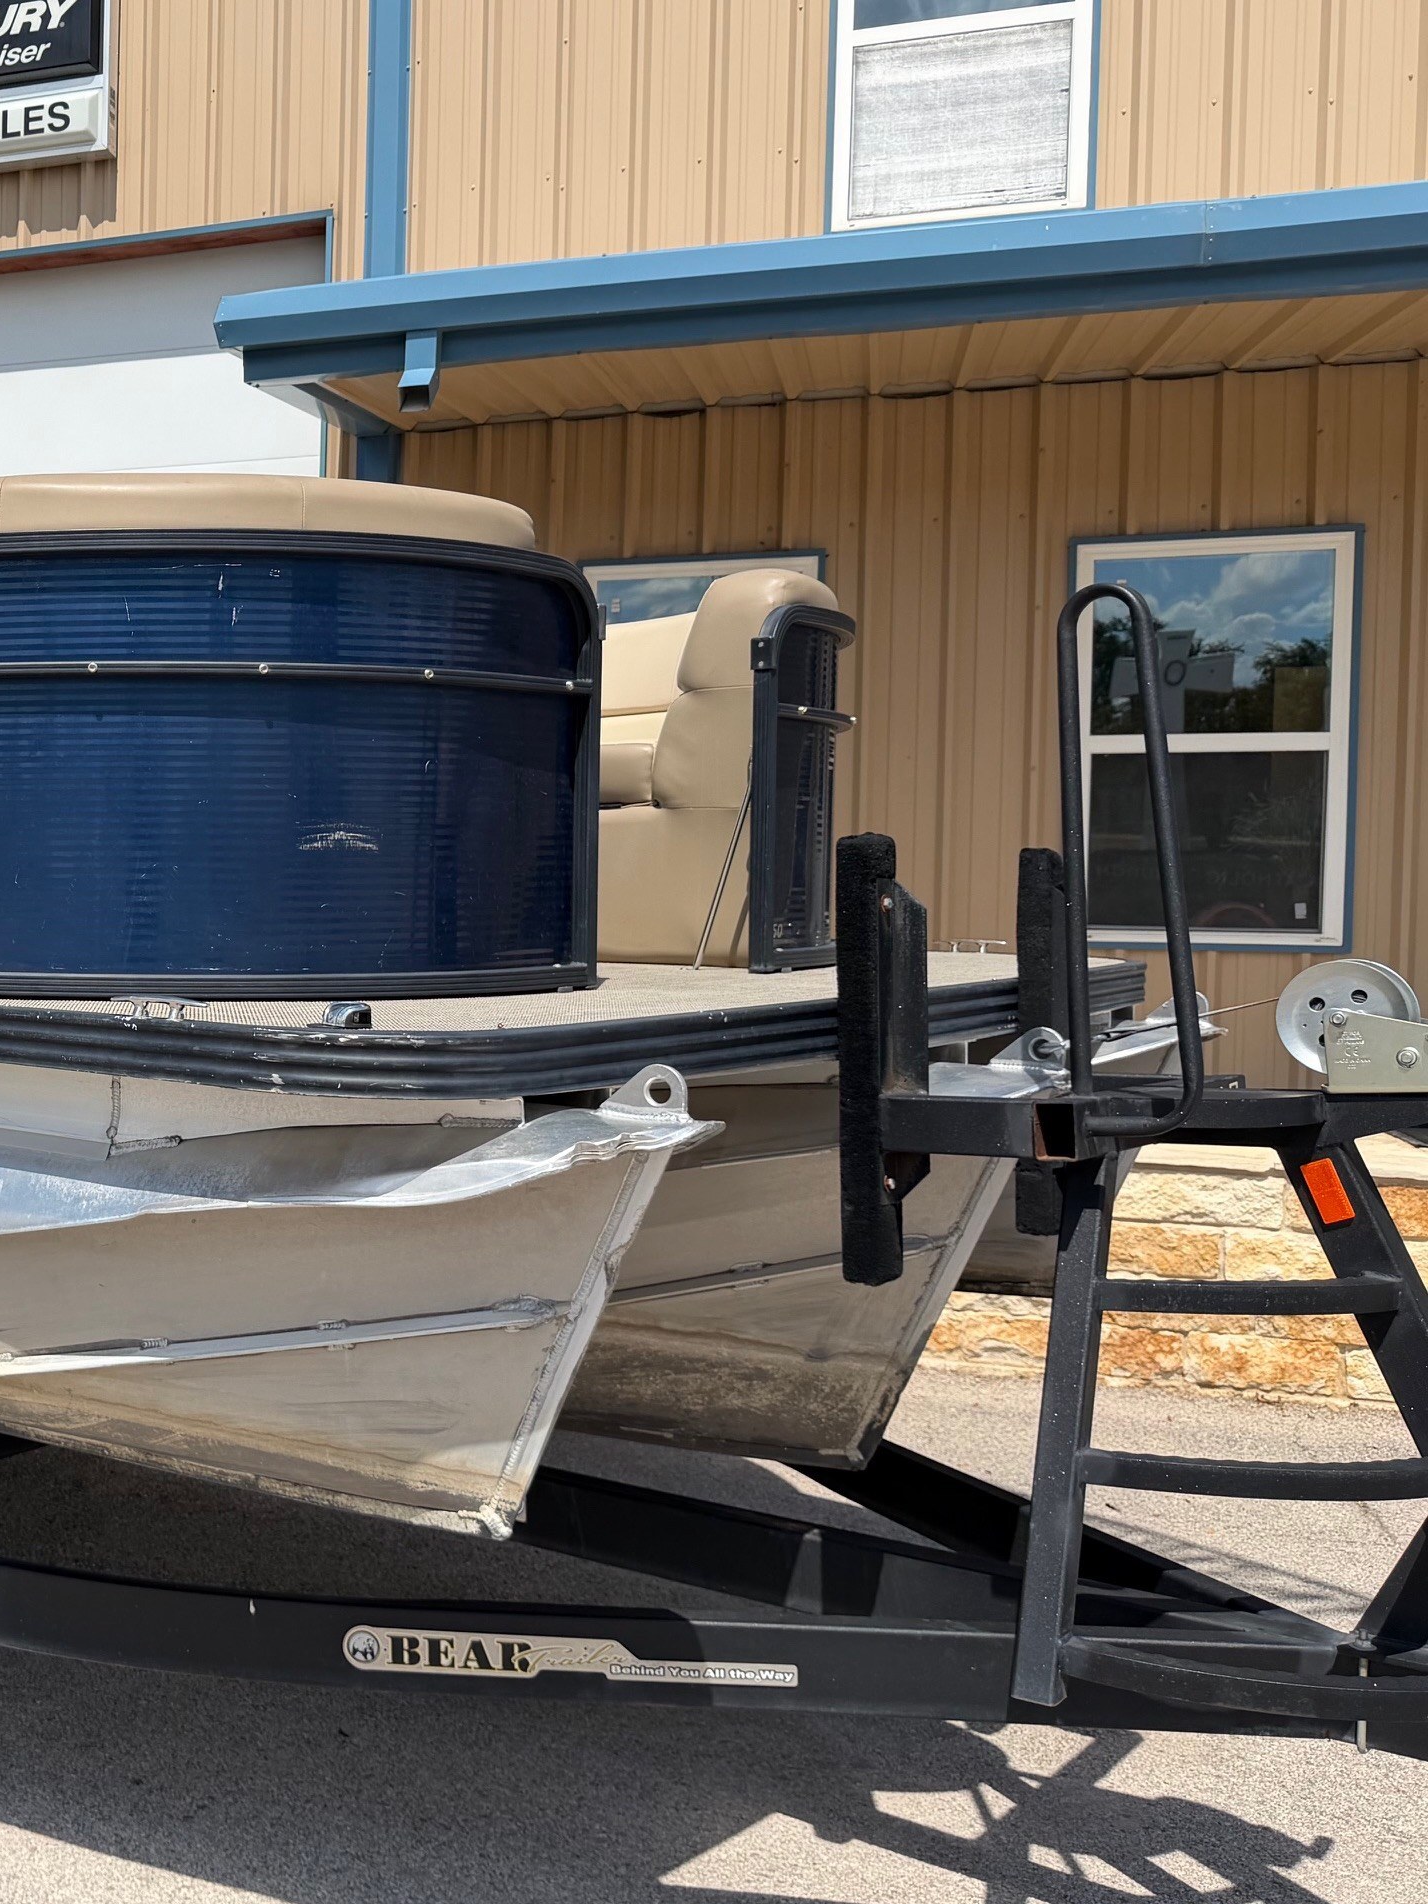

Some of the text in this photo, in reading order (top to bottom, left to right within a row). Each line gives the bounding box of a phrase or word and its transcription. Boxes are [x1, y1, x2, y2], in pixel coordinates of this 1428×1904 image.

[386, 1634, 533, 1673] BEAR
[610, 1663, 795, 1684] Behind You All the Way
